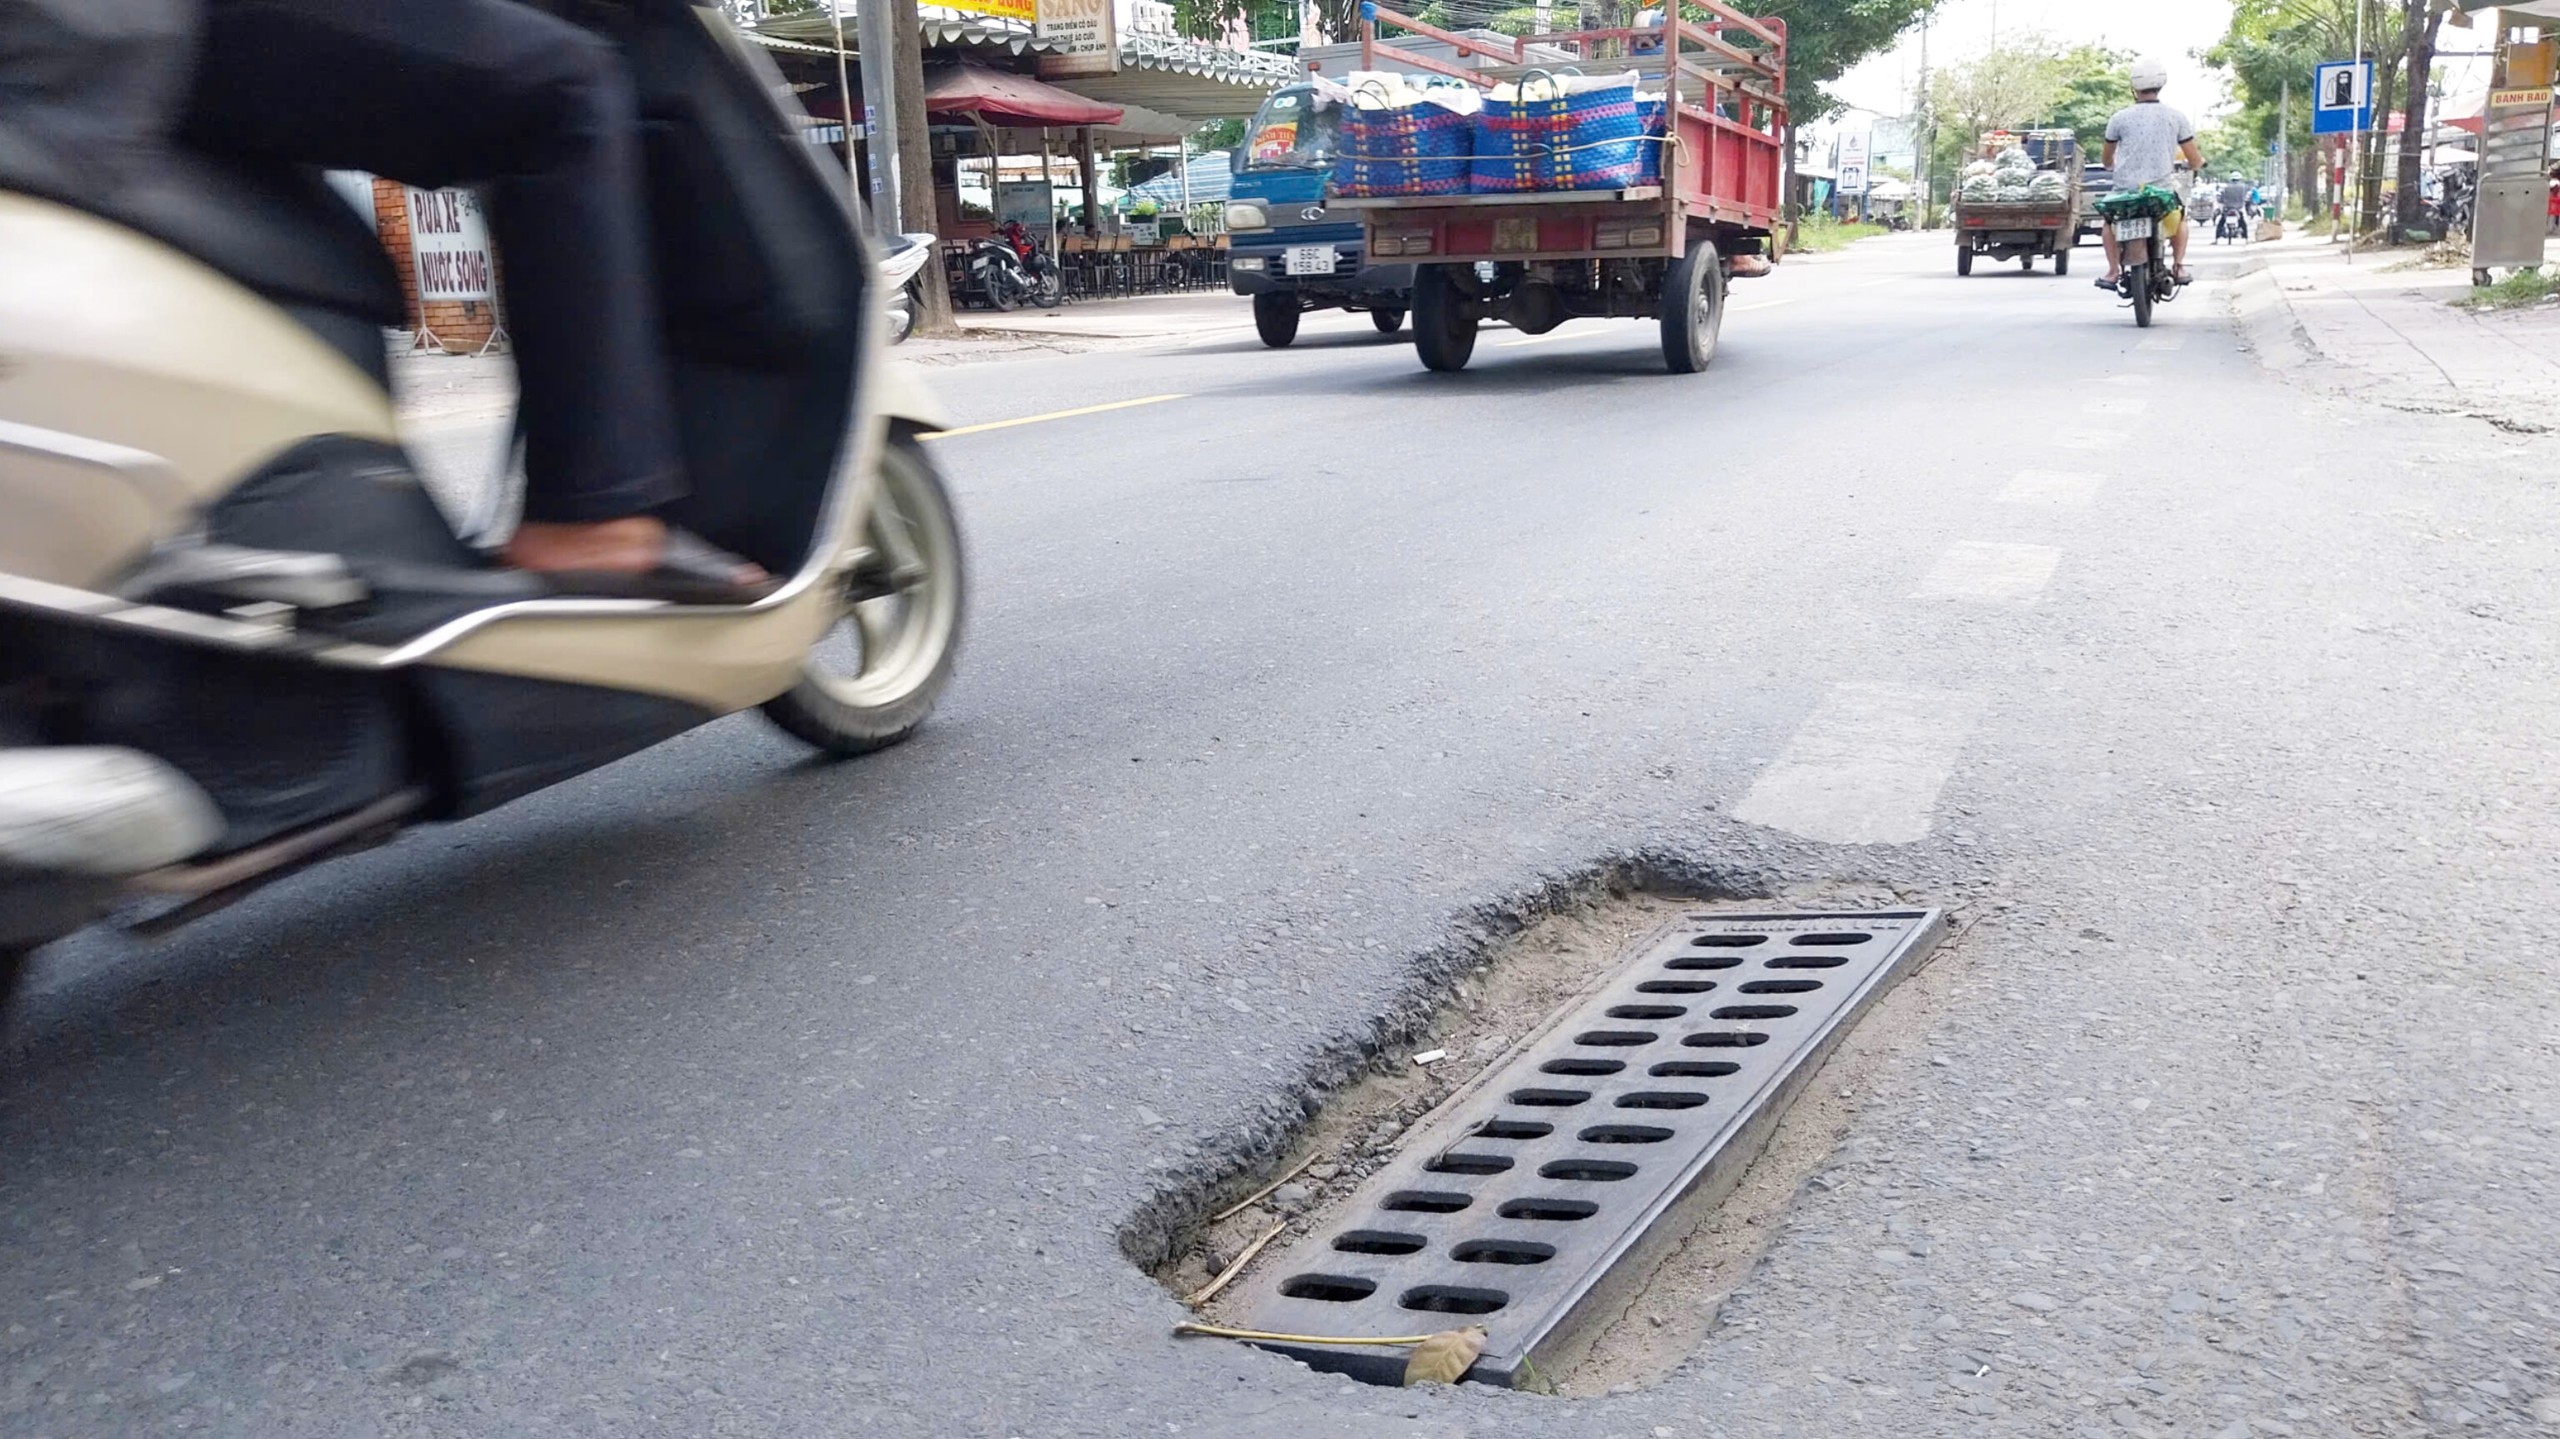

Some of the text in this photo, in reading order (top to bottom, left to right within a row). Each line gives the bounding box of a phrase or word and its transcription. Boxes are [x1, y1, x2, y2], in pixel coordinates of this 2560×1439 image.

[1046, 23, 1064, 31] TRANG
[2527, 92, 2548, 102] BAO
[441, 190, 461, 233] XE
